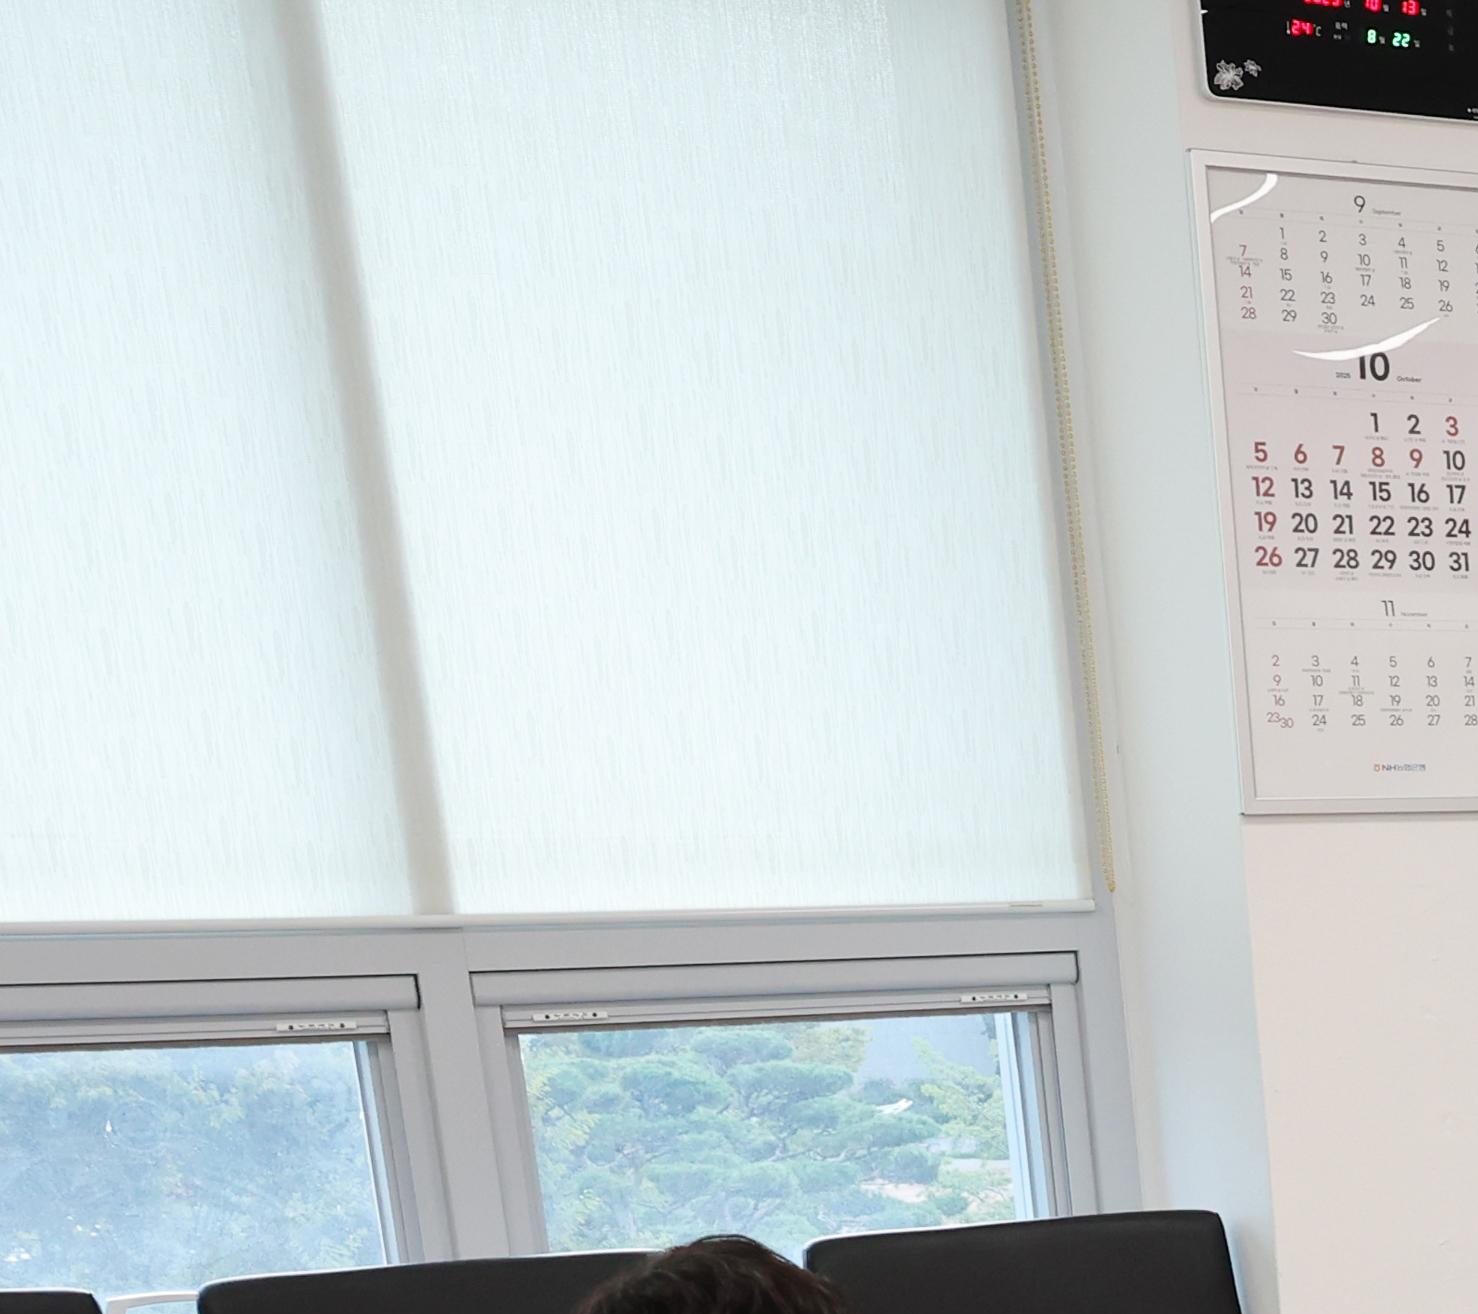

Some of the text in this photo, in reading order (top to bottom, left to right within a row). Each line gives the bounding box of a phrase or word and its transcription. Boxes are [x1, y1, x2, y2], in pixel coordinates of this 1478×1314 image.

[1291, 19, 1312, 35] 24
[1367, 29, 1410, 47] 8 22
[1354, 196, 1365, 213] 9
[1279, 227, 1285, 239] 1
[1319, 230, 1327, 242] 2
[1359, 233, 1367, 246] 3
[1398, 237, 1405, 248] 4
[1437, 240, 1445, 252] 5
[1239, 245, 1247, 256] 7
[1280, 248, 1288, 260] 8
[1320, 251, 1328, 262] 9
[1358, 254, 1370, 266] 10
[1399, 257, 1408, 268] 11
[1436, 259, 1448, 272] 12
[1239, 266, 1252, 278] 14
[1280, 268, 1292, 281] 15
[1321, 272, 1332, 283] 16
[1360, 274, 1371, 286] 17
[1399, 277, 1411, 289] 18
[1438, 280, 1449, 291] 19
[1240, 286, 1252, 298] 21
[1280, 289, 1295, 301] 22
[1321, 292, 1335, 304] 23
[1360, 294, 1375, 306] 24
[1400, 297, 1414, 309] 25
[1438, 300, 1453, 312] 26
[1241, 307, 1337, 325] 28 29 30
[1359, 352, 1390, 381] 10
[1370, 413, 1378, 432] 1
[1407, 414, 1421, 434] 2
[1446, 416, 1459, 436] 3
[1255, 442, 1268, 462] 5
[1294, 444, 1307, 464] 6
[1332, 445, 1344, 465] 7
[1372, 447, 1385, 467] 8
[1410, 449, 1423, 468] 9
[1443, 450, 1465, 471] 10
[1252, 476, 1275, 497] 12
[1291, 478, 1313, 499] 13
[1330, 480, 1353, 500] 14
[1369, 481, 1391, 502] 15
[1408, 483, 1430, 503] 16
[1446, 485, 1466, 504] 17
[1254, 512, 1277, 532] 19
[1292, 513, 1318, 533] 20
[1333, 514, 1353, 534] 21
[1369, 515, 1395, 536] 22
[1407, 517, 1433, 537] 23
[1445, 518, 1471, 538] 24
[1255, 546, 1469, 571] 26 27 28 29 30 31
[1381, 600, 1395, 616] 11
[1272, 655, 1280, 666] 2
[1312, 655, 1319, 667] 3
[1351, 656, 1359, 666] 4
[1390, 656, 1397, 668] 5
[1428, 657, 1435, 668] 6
[1465, 657, 1472, 667] 7
[1273, 674, 1281, 686] 9
[1311, 675, 1323, 687] 10
[1351, 675, 1361, 687] 11
[1389, 675, 1400, 687] 12
[1426, 676, 1437, 687] 13
[1464, 676, 1475, 687] 14
[1273, 695, 1285, 706] 16
[1313, 695, 1323, 706] 17
[1352, 695, 1363, 707] 18
[1390, 695, 1401, 706] 19
[1426, 695, 1440, 707] 20
[1465, 695, 1475, 706] 21
[1267, 712, 1282, 723] 23
[1281, 716, 1294, 728] 30
[1312, 714, 1327, 726] 24
[1351, 714, 1365, 726] 25
[1389, 714, 1404, 726] 26
[1428, 714, 1440, 726] 27
[1464, 714, 1478, 726] 28
